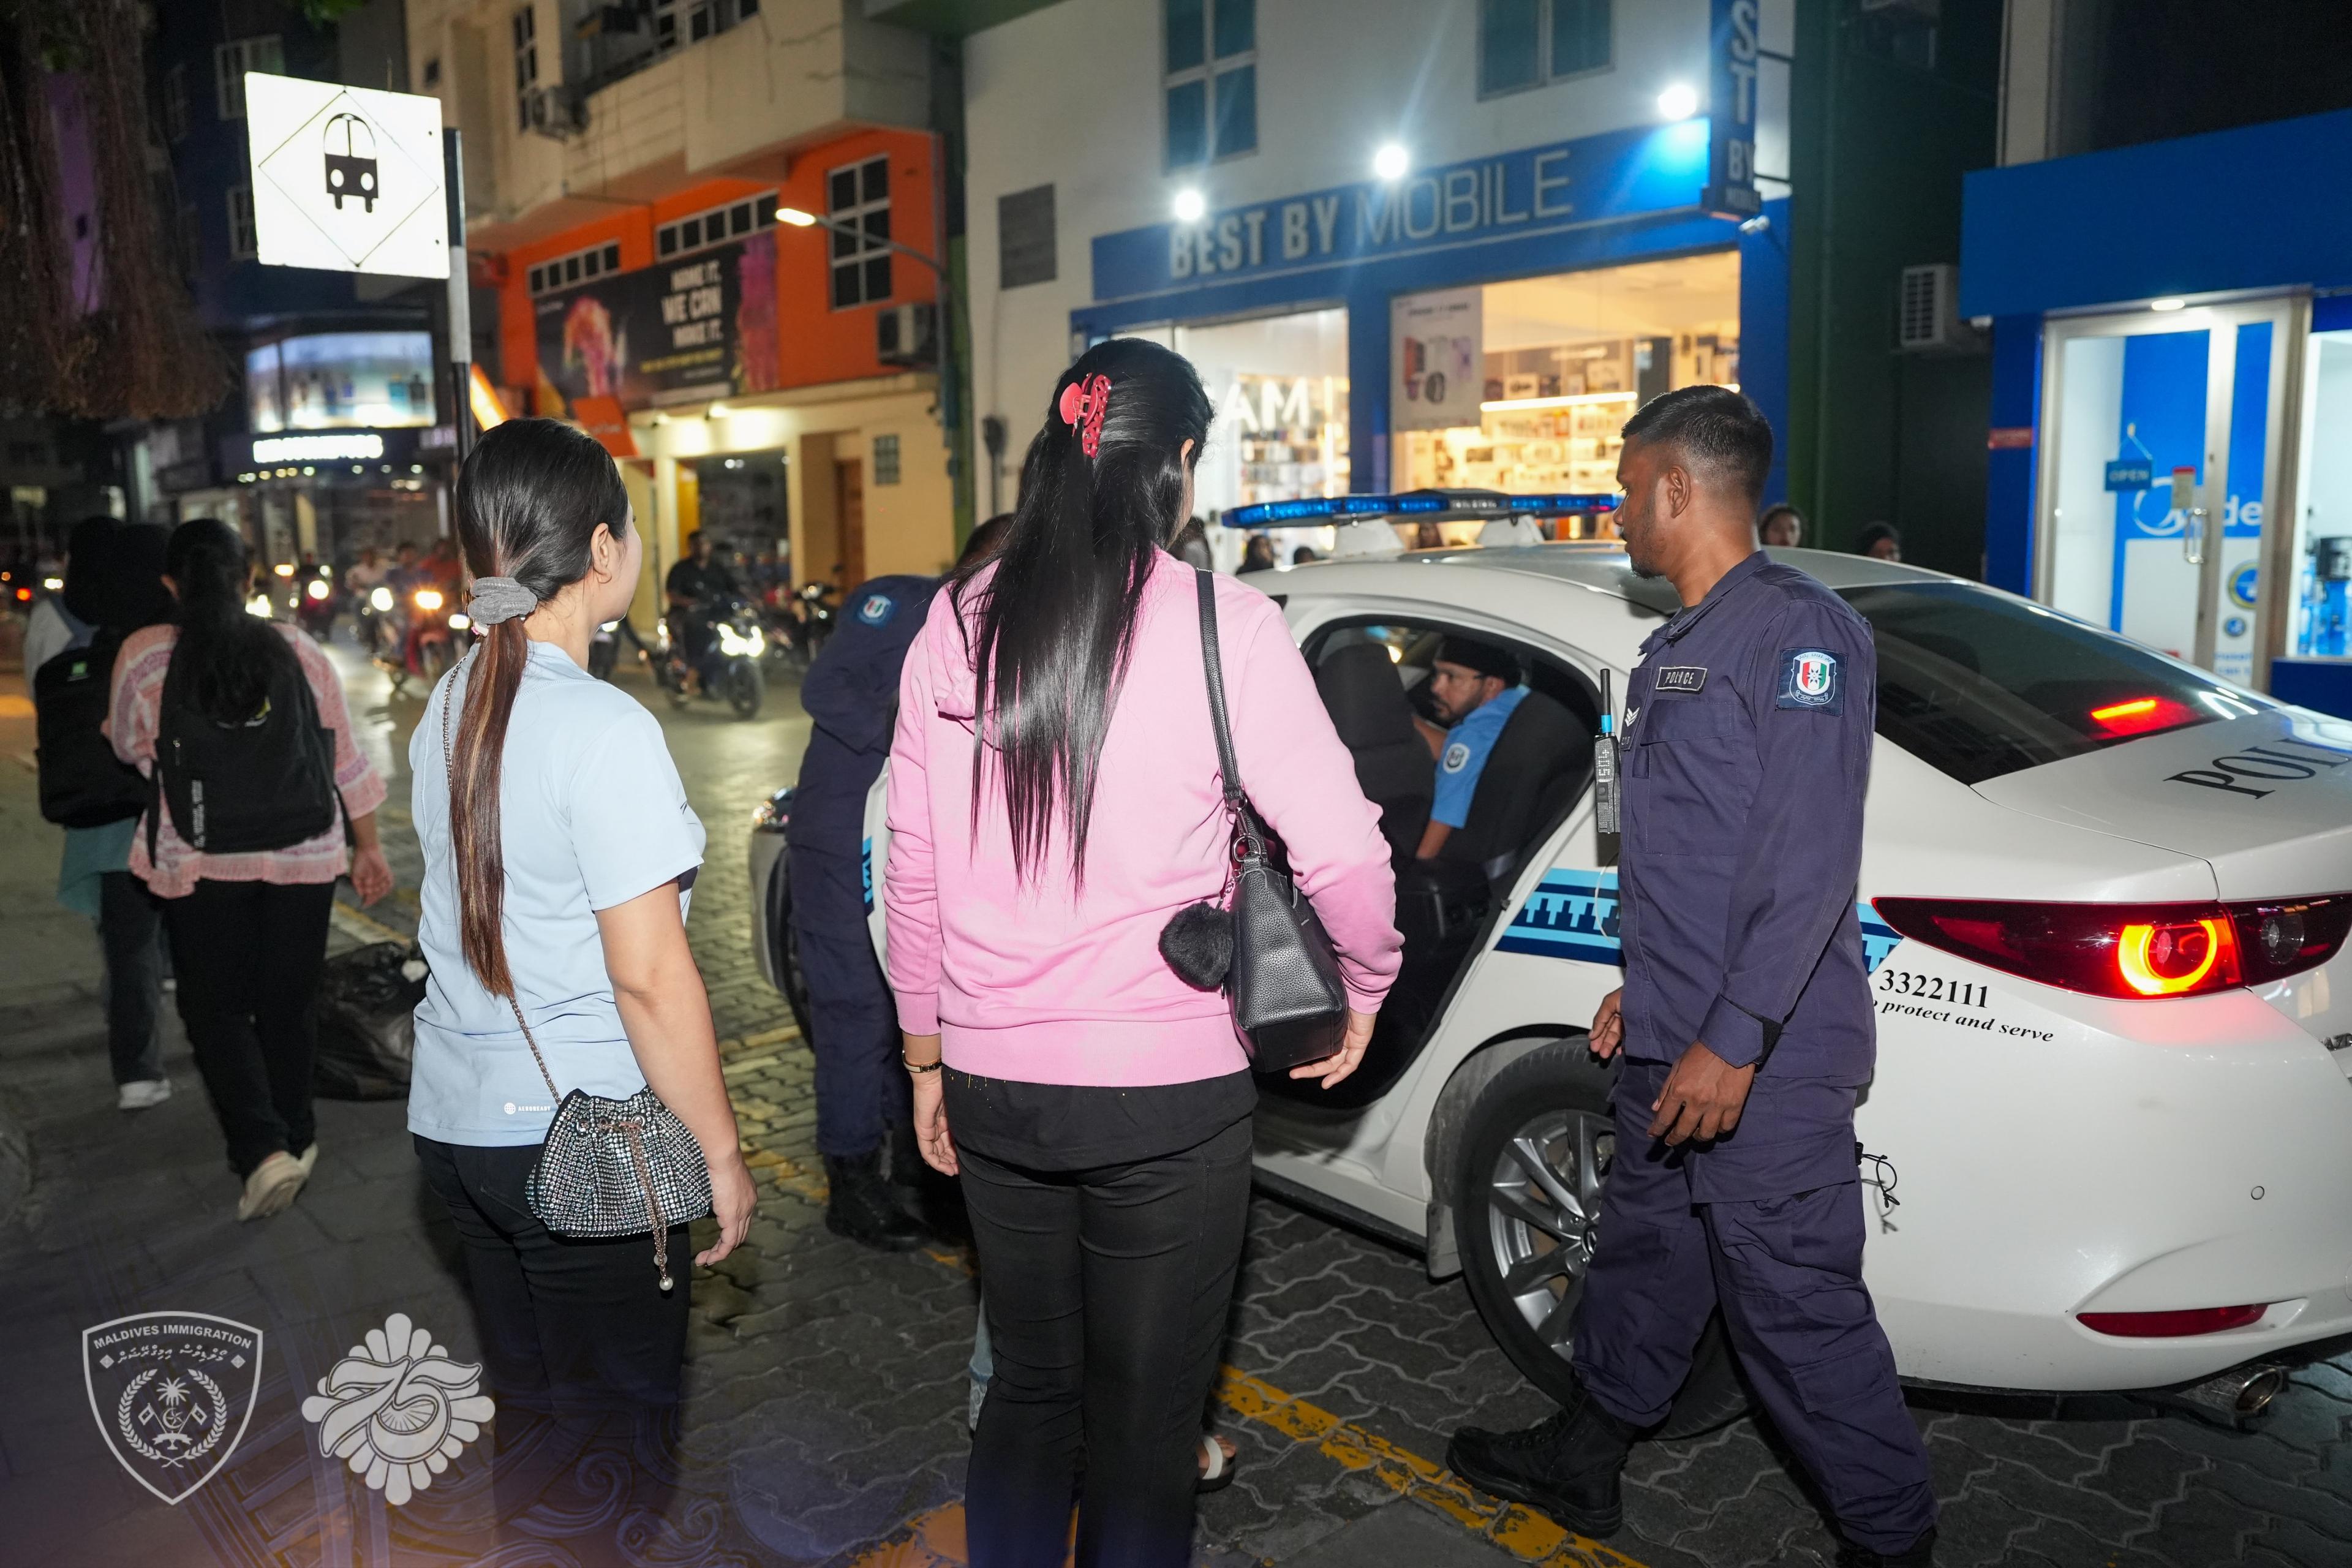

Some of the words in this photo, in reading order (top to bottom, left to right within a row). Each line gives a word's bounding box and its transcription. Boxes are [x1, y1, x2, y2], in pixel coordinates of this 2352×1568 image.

[1170, 209, 1266, 279] BEST
[1284, 196, 1339, 259] BY
[1355, 150, 1572, 246] MOBILE
[2109, 469, 2149, 482] OPEN
[1665, 671, 1694, 684] POLICE
[1879, 969, 1988, 1009] 3322111
[1880, 1000, 1951, 1022] protect
[1955, 1016, 1996, 1031] and
[1998, 1024, 2054, 1042] serve
